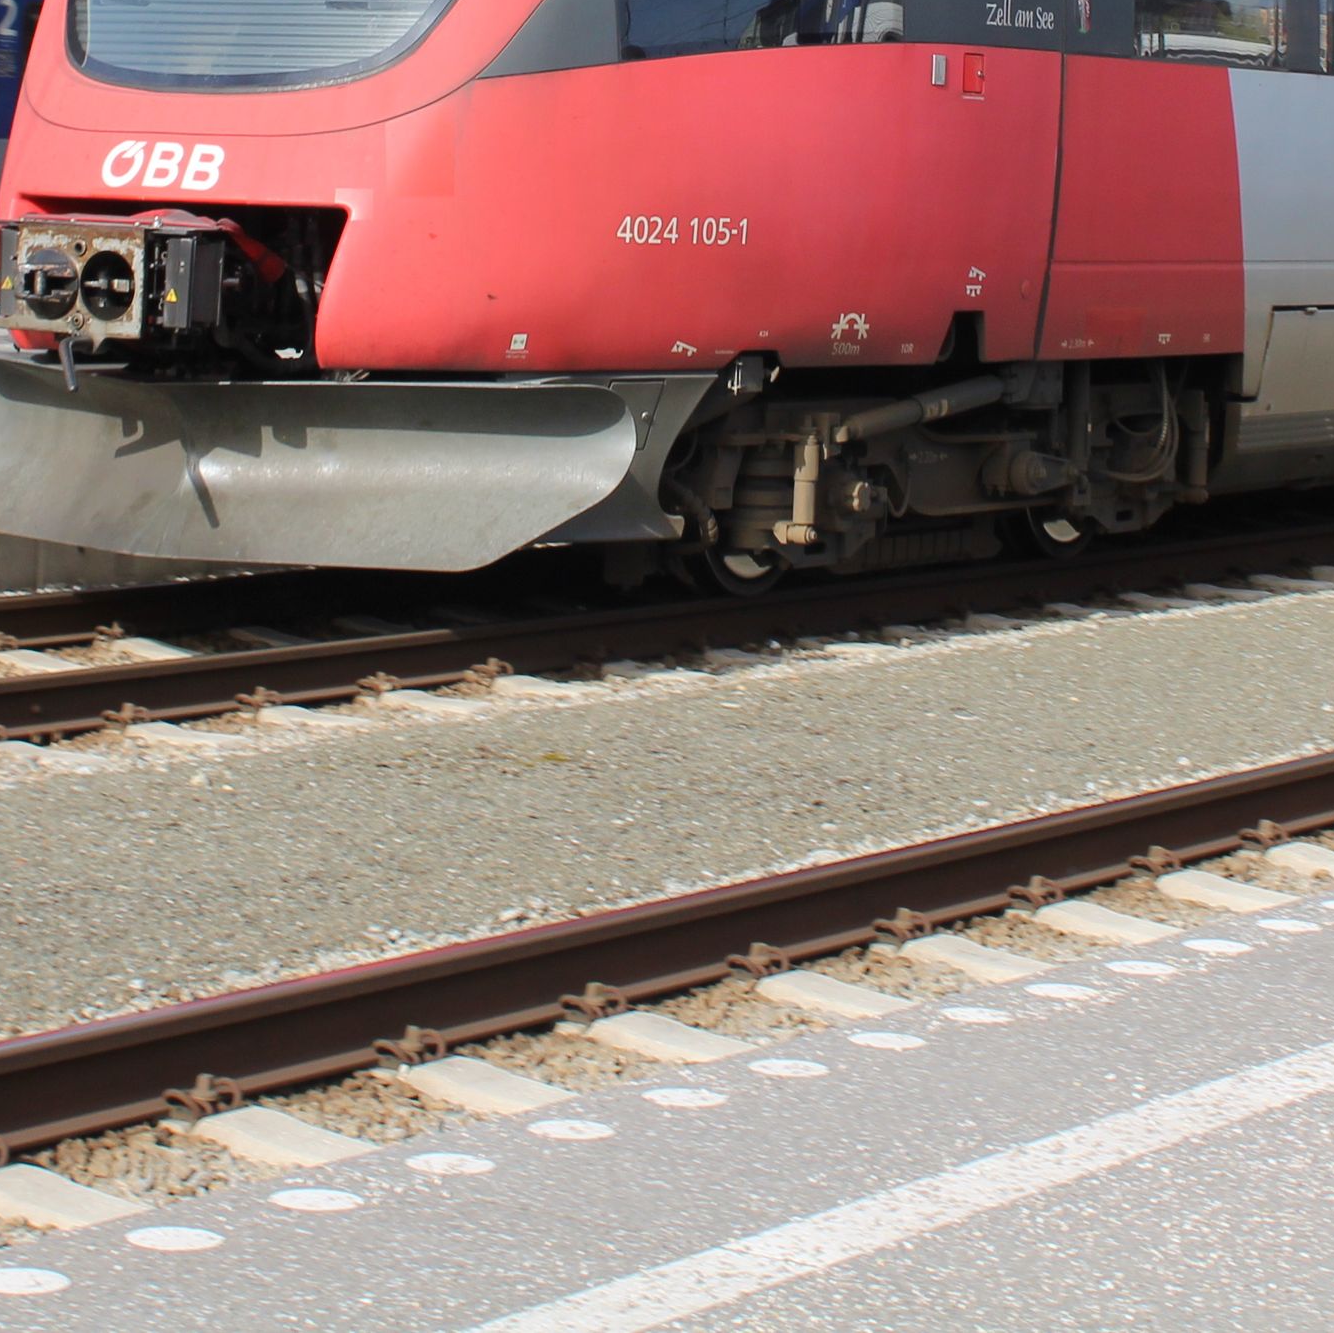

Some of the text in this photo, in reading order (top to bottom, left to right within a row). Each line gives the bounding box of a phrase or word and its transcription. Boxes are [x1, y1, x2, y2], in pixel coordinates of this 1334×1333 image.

[1015, 9, 1034, 28] am
[1036, 6, 1055, 30] See
[101, 140, 225, 191] ÖBB
[617, 215, 748, 245] 4024 105-1
[831, 341, 860, 356] 500m
